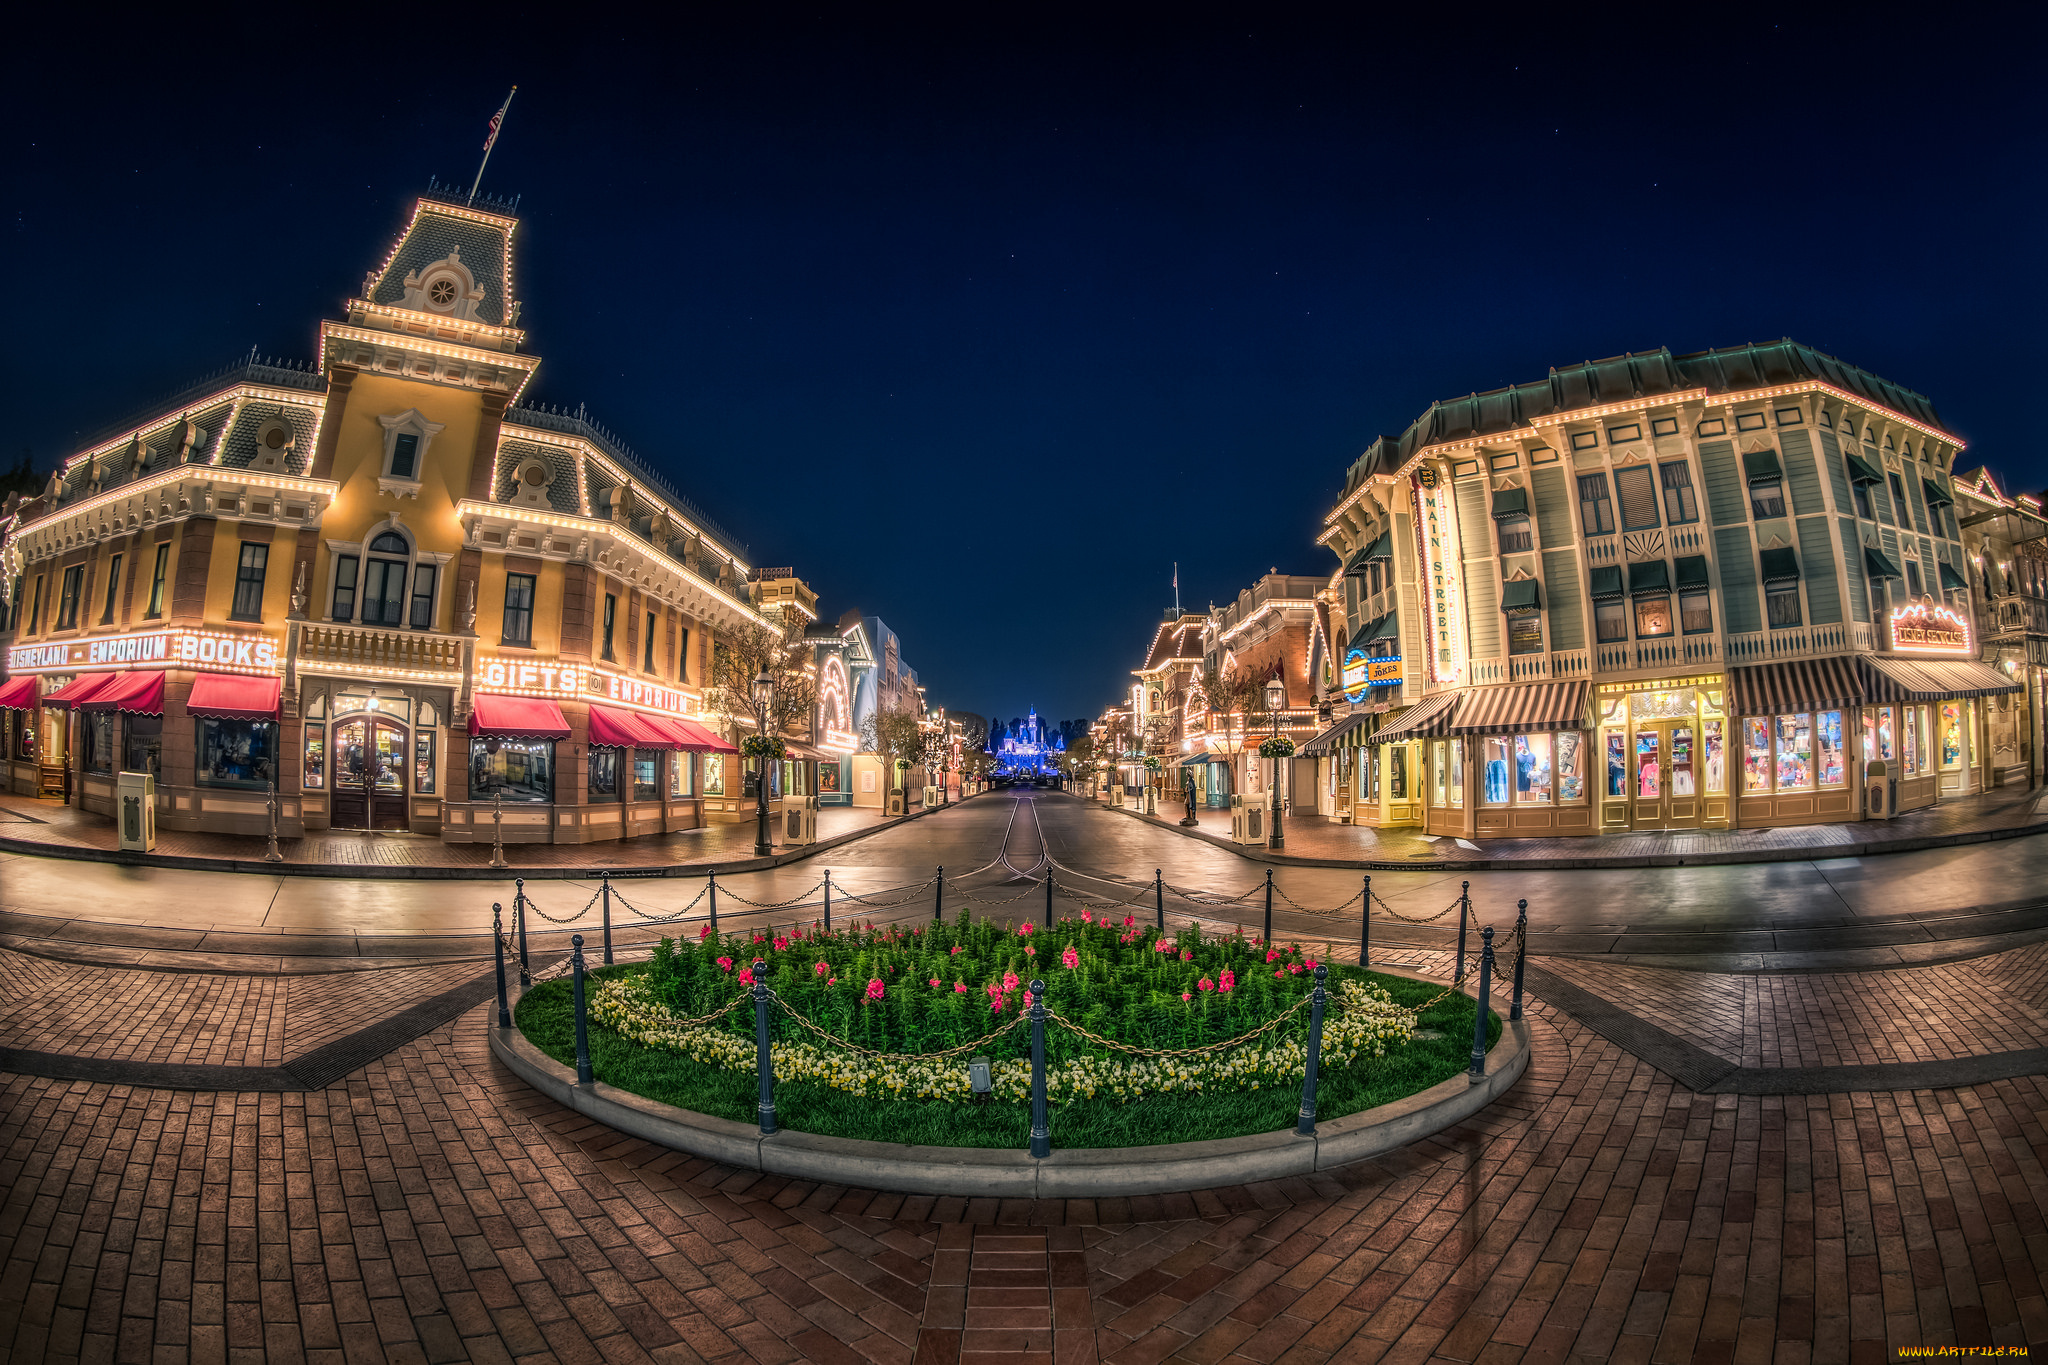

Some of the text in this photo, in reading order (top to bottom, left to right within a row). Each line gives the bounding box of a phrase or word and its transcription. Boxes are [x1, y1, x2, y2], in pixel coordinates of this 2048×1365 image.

[1425, 498, 1440, 547] MAIN
[1433, 562, 1449, 641] STREET
[1898, 626, 1926, 643] DISNEY
[11, 645, 69, 668] DISNEYLAND
[89, 635, 167, 664] EMPORIUM
[181, 635, 275, 667] BOOKS
[487, 663, 577, 692] GIFTS
[1373, 664, 1398, 678] JOKES
[610, 678, 687, 713] EMPORIUM
